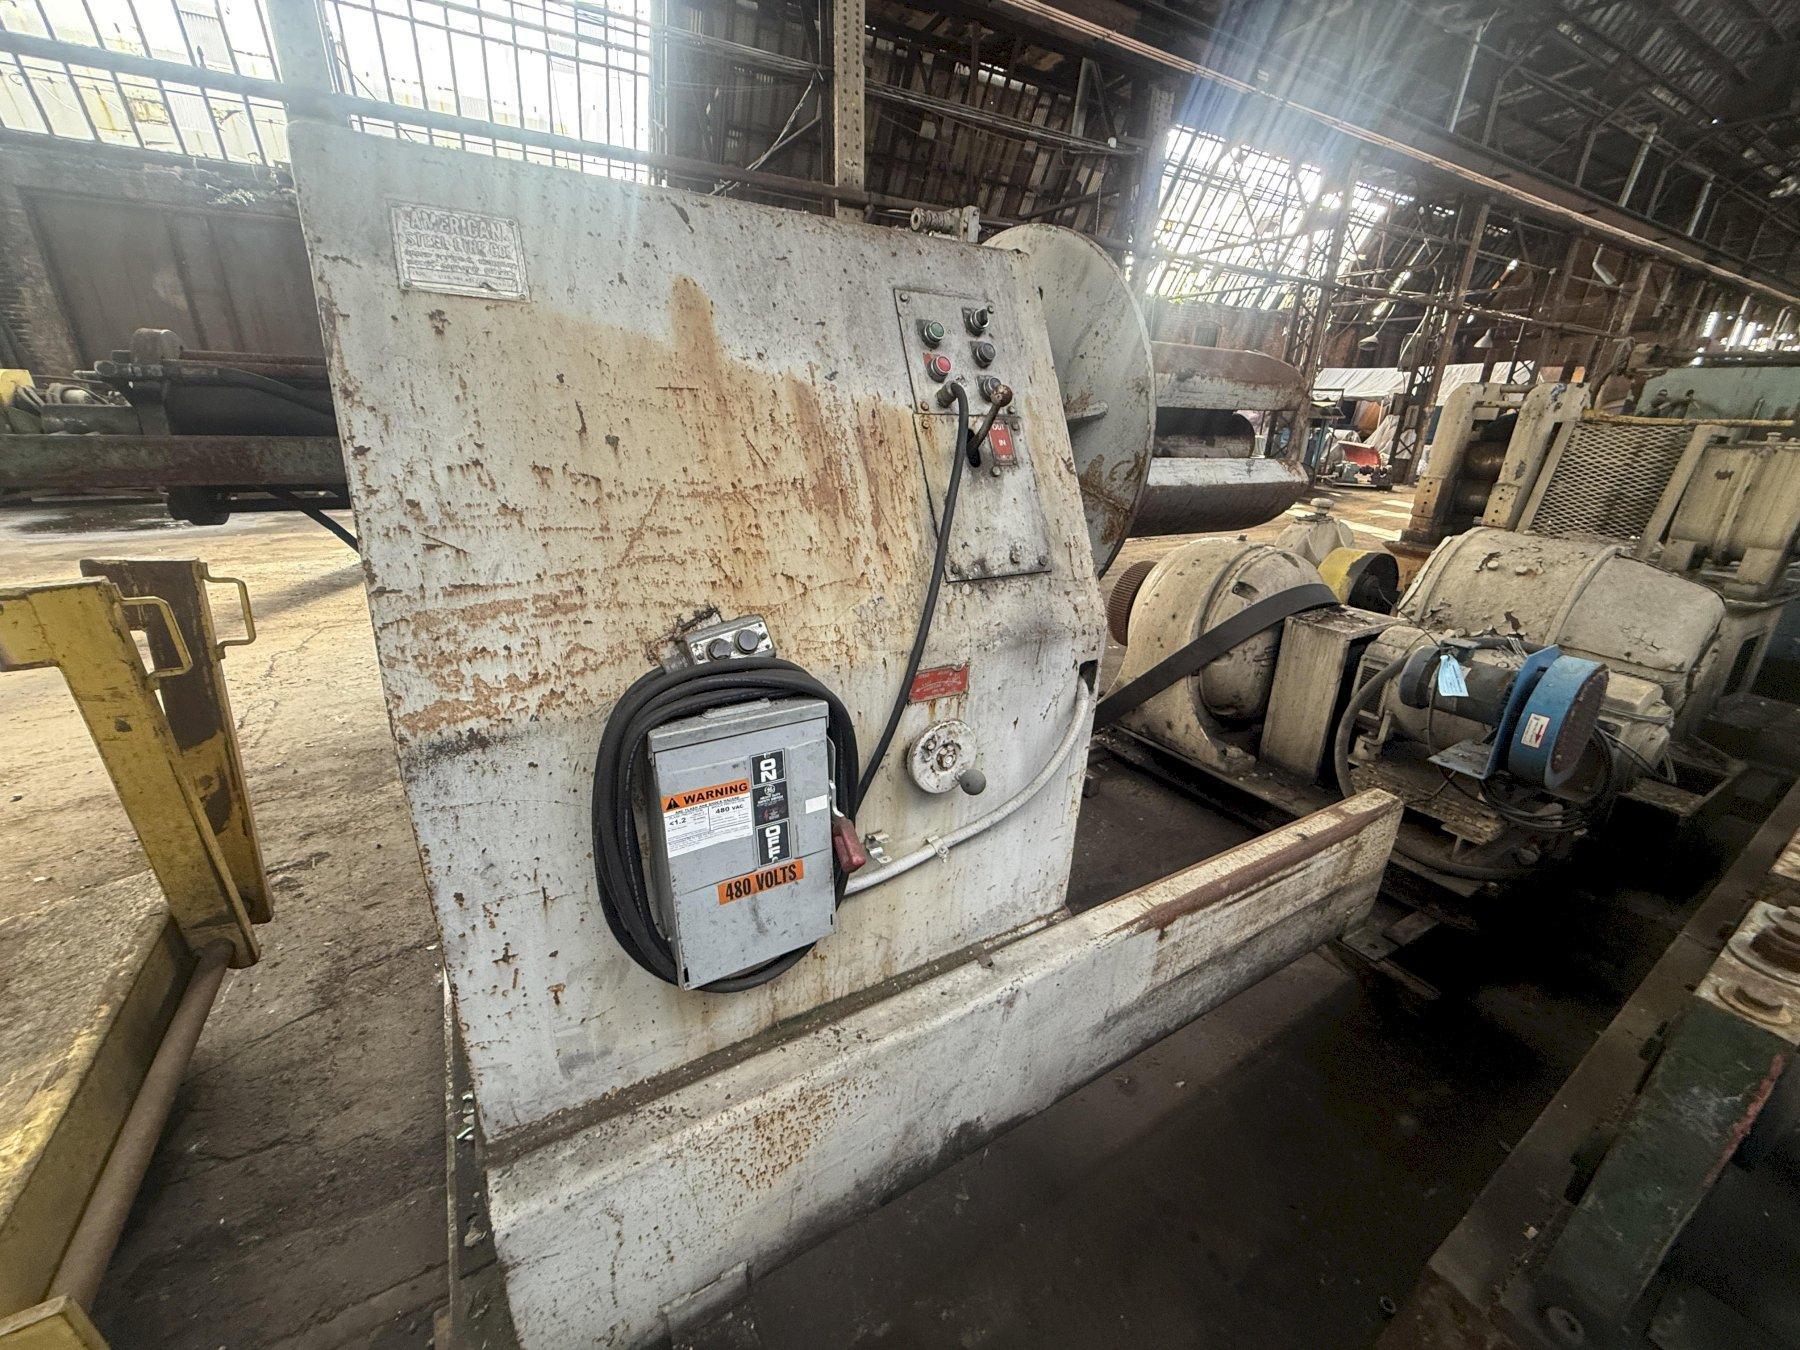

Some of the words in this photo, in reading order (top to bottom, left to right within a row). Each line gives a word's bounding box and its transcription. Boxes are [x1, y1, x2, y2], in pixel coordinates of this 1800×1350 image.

[410, 210, 503, 241] AMERICAN
[406, 233, 449, 250] STEEL
[760, 757, 777, 783] ON
[683, 782, 748, 805] WARNING
[715, 806, 730, 814] 480
[732, 803, 744, 811] VAC
[765, 824, 781, 859] OFF
[726, 878, 751, 901] 480
[755, 863, 797, 891] VOLTS
